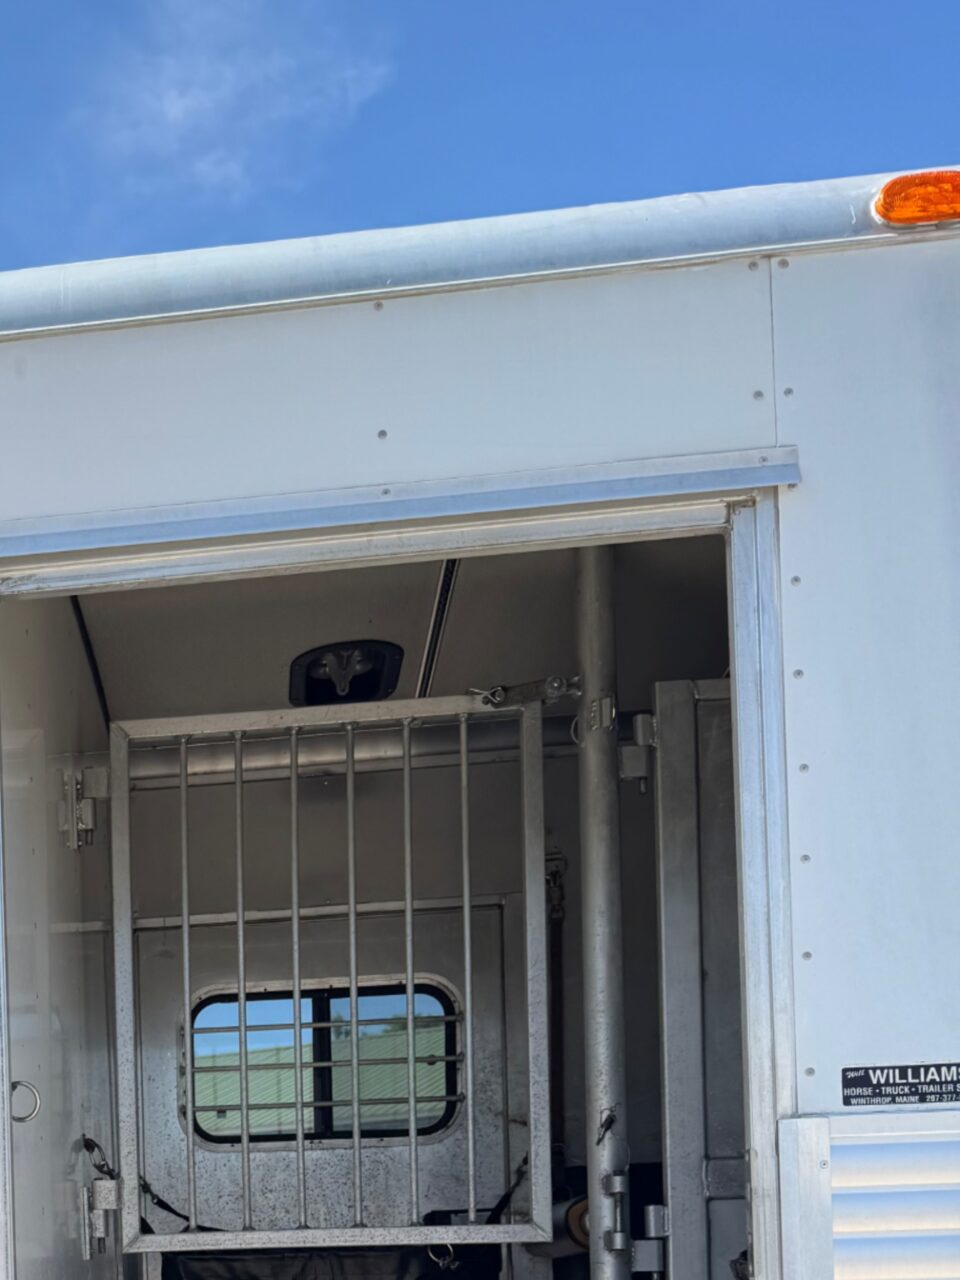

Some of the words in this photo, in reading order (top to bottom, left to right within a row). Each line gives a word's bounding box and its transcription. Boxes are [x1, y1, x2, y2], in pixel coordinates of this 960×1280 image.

[869, 1066, 960, 1085] WILLIAM
[843, 1087, 873, 1097] HORSE
[881, 1085, 911, 1095] TRUCK
[916, 1083, 954, 1094] TRAILER
[895, 1095, 920, 1104] MAINE
